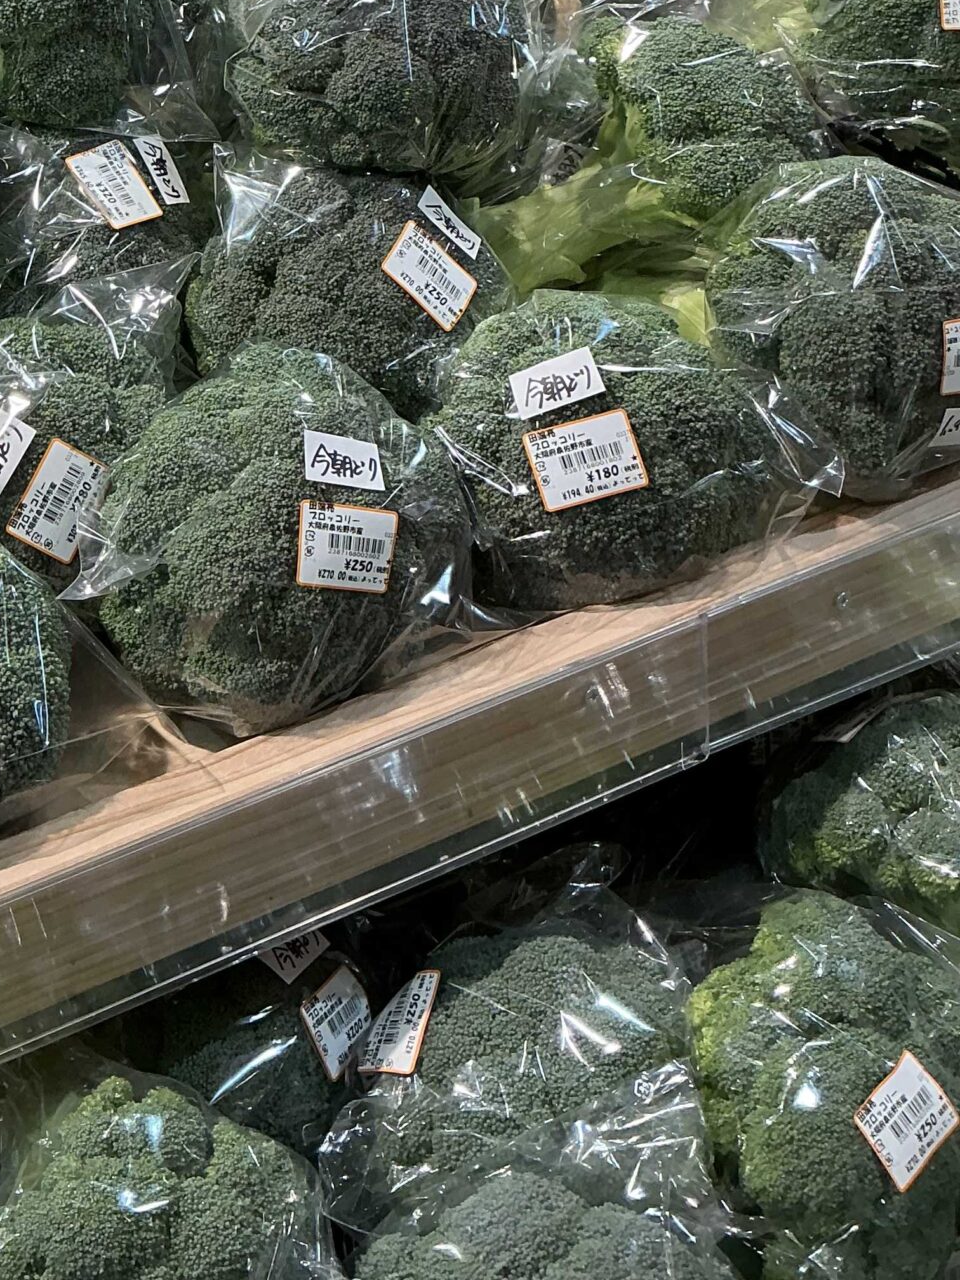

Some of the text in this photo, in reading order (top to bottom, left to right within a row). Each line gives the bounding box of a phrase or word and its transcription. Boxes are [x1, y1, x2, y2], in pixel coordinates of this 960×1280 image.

[94, 180, 116, 204] ¥320
[423, 280, 448, 307] ¥250
[585, 464, 620, 483] ¥180
[70, 480, 92, 514] ¥280
[343, 558, 373, 572] ¥250
[398, 993, 423, 1024] ¥250
[345, 1014, 364, 1045] ¥200
[913, 1111, 938, 1144] ¥250
